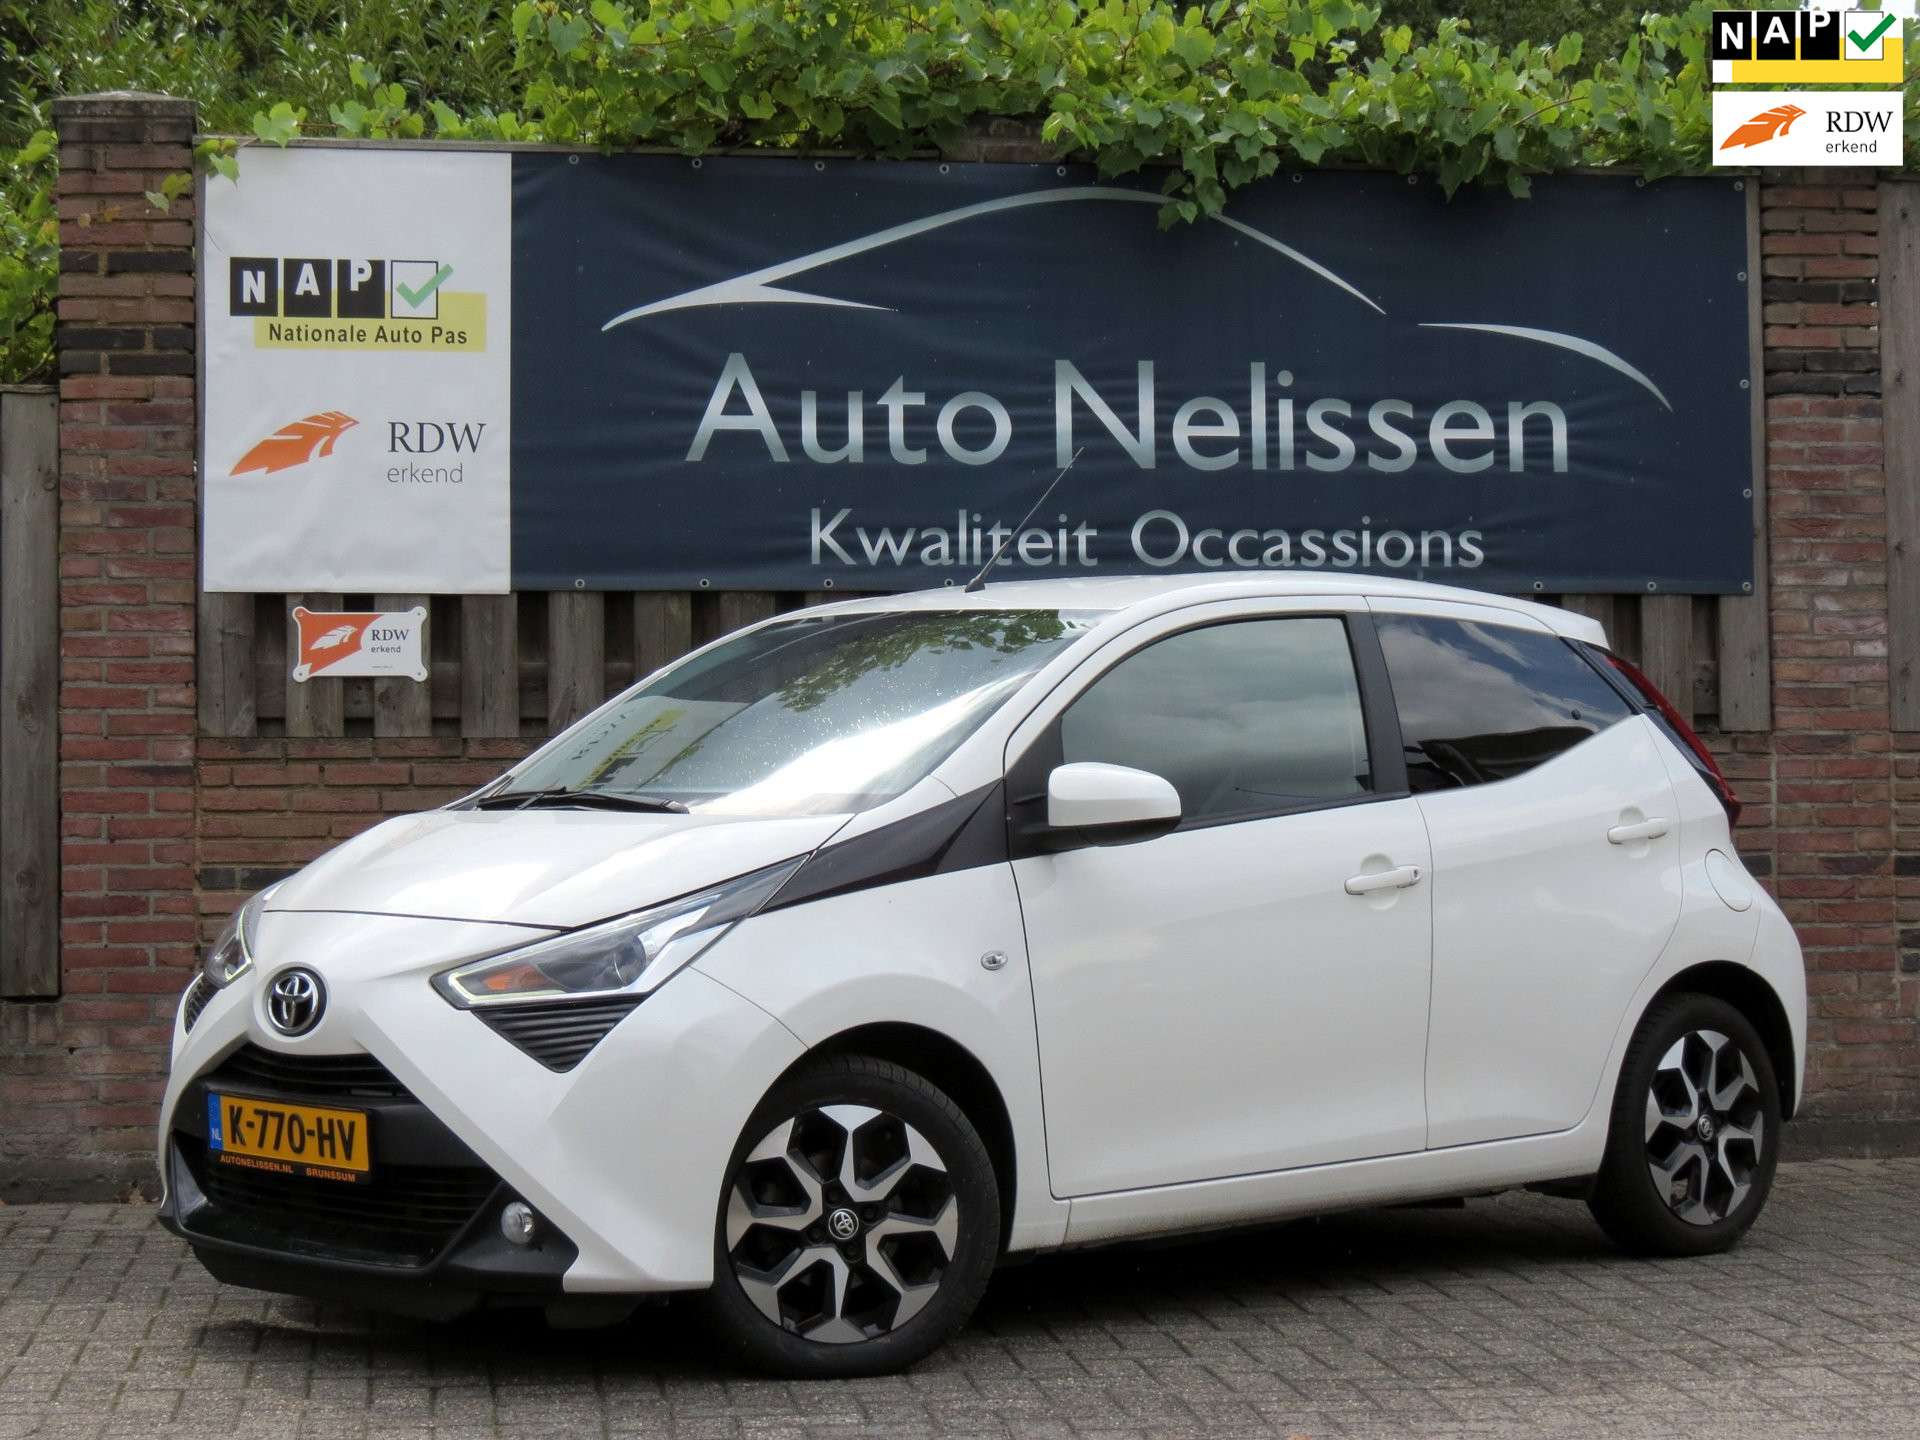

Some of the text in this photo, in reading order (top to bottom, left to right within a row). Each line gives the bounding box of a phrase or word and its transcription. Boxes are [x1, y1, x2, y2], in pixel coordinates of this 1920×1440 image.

[242, 260, 373, 304] NAP
[269, 323, 467, 344] Nationale Auto Pas
[685, 352, 1569, 474] Auto Nelissen
[387, 421, 487, 453] RDW
[387, 462, 463, 484] erkend
[811, 507, 1484, 568] Kwaliteit Occassions
[371, 629, 410, 641] RDW
[371, 644, 401, 653] erkend
[211, 1127, 222, 1141] NL
[229, 1104, 356, 1162] K-770-HV
[220, 1155, 356, 1182] AUTONELISSEN.NL BRUNSSUM
